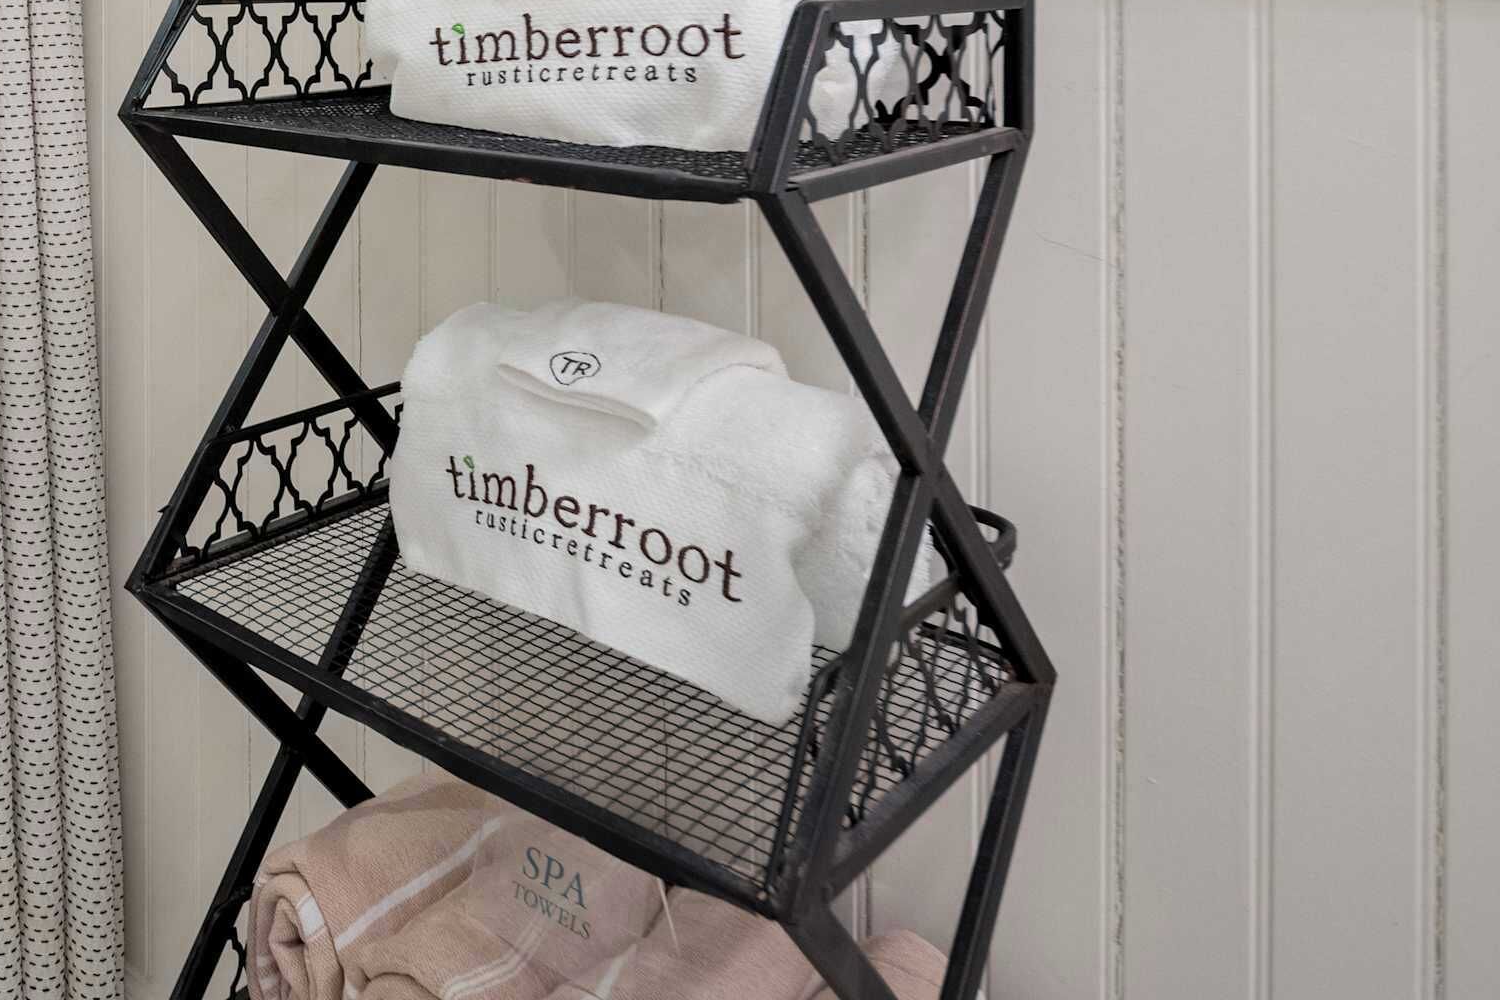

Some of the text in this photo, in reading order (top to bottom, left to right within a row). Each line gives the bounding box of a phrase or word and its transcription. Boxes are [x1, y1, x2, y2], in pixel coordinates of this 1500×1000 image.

[429, 13, 745, 66] timberroot
[467, 63, 698, 87] rusticretreats
[559, 356, 592, 377] TR
[446, 455, 742, 602] timberroot
[475, 508, 692, 607] rusticretreats
[521, 846, 588, 910] SPA
[512, 880, 591, 940] TOWELS
